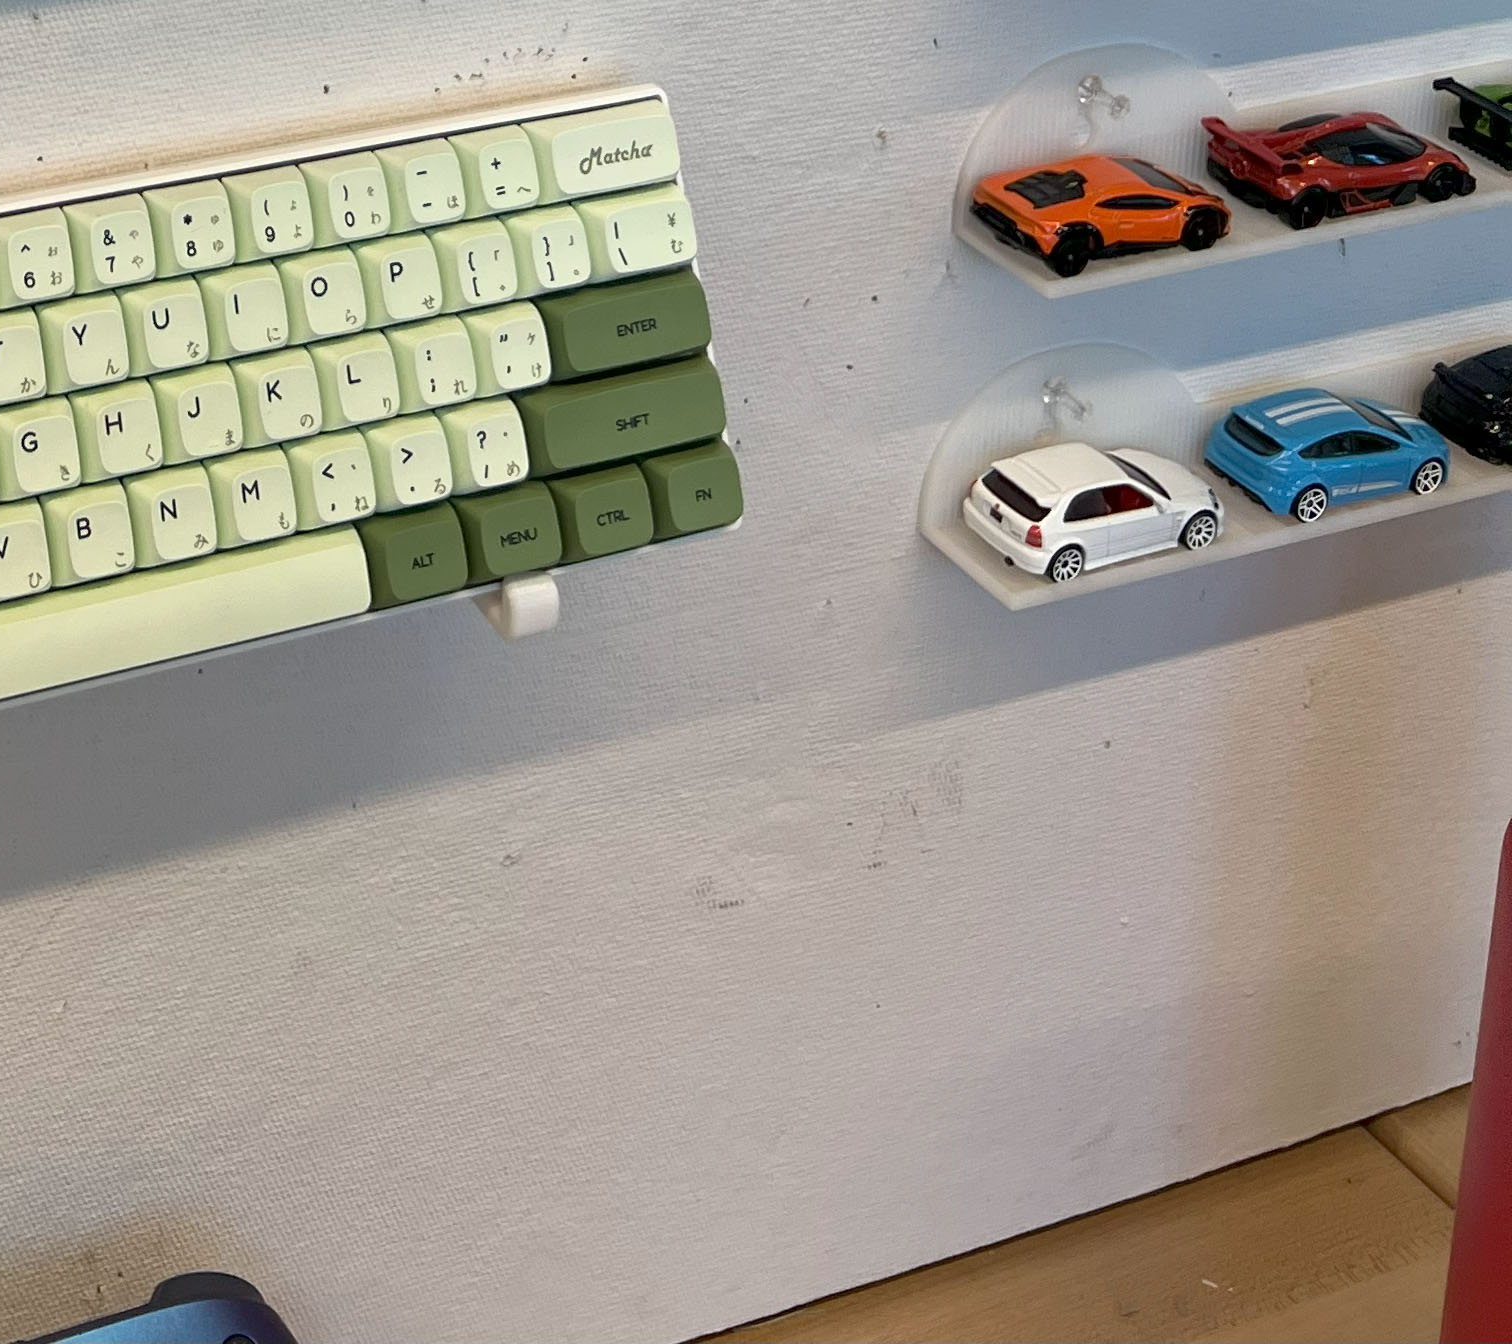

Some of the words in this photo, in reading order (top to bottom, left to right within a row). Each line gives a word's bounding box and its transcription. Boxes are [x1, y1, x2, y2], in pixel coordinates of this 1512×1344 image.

[579, 140, 653, 175] Matcha
[342, 185, 349, 201] )
[263, 200, 270, 216] (
[345, 211, 355, 227] 0
[103, 229, 116, 246] &
[265, 226, 275, 243] 9
[186, 240, 197, 257] 8
[105, 256, 115, 273] 7
[390, 262, 403, 283] P
[24, 272, 36, 288] 6
[311, 277, 328, 297] O
[233, 294, 240, 314] I
[152, 308, 169, 330] U
[617, 318, 657, 337] ENTER
[72, 324, 87, 346] Y
[346, 365, 361, 385] L
[266, 380, 282, 403] K
[188, 396, 200, 418] J
[105, 411, 123, 436] H
[616, 413, 649, 431] SHIFT
[21, 432, 38, 453] G
[476, 431, 486, 449] ?
[401, 448, 413, 464] >
[322, 463, 334, 479] <
[241, 480, 260, 504] M
[695, 488, 712, 502] FN
[160, 499, 177, 522] N
[596, 510, 630, 527] CTRL
[76, 517, 91, 540] B
[500, 527, 538, 548] MENU
[412, 552, 434, 570] ALT
